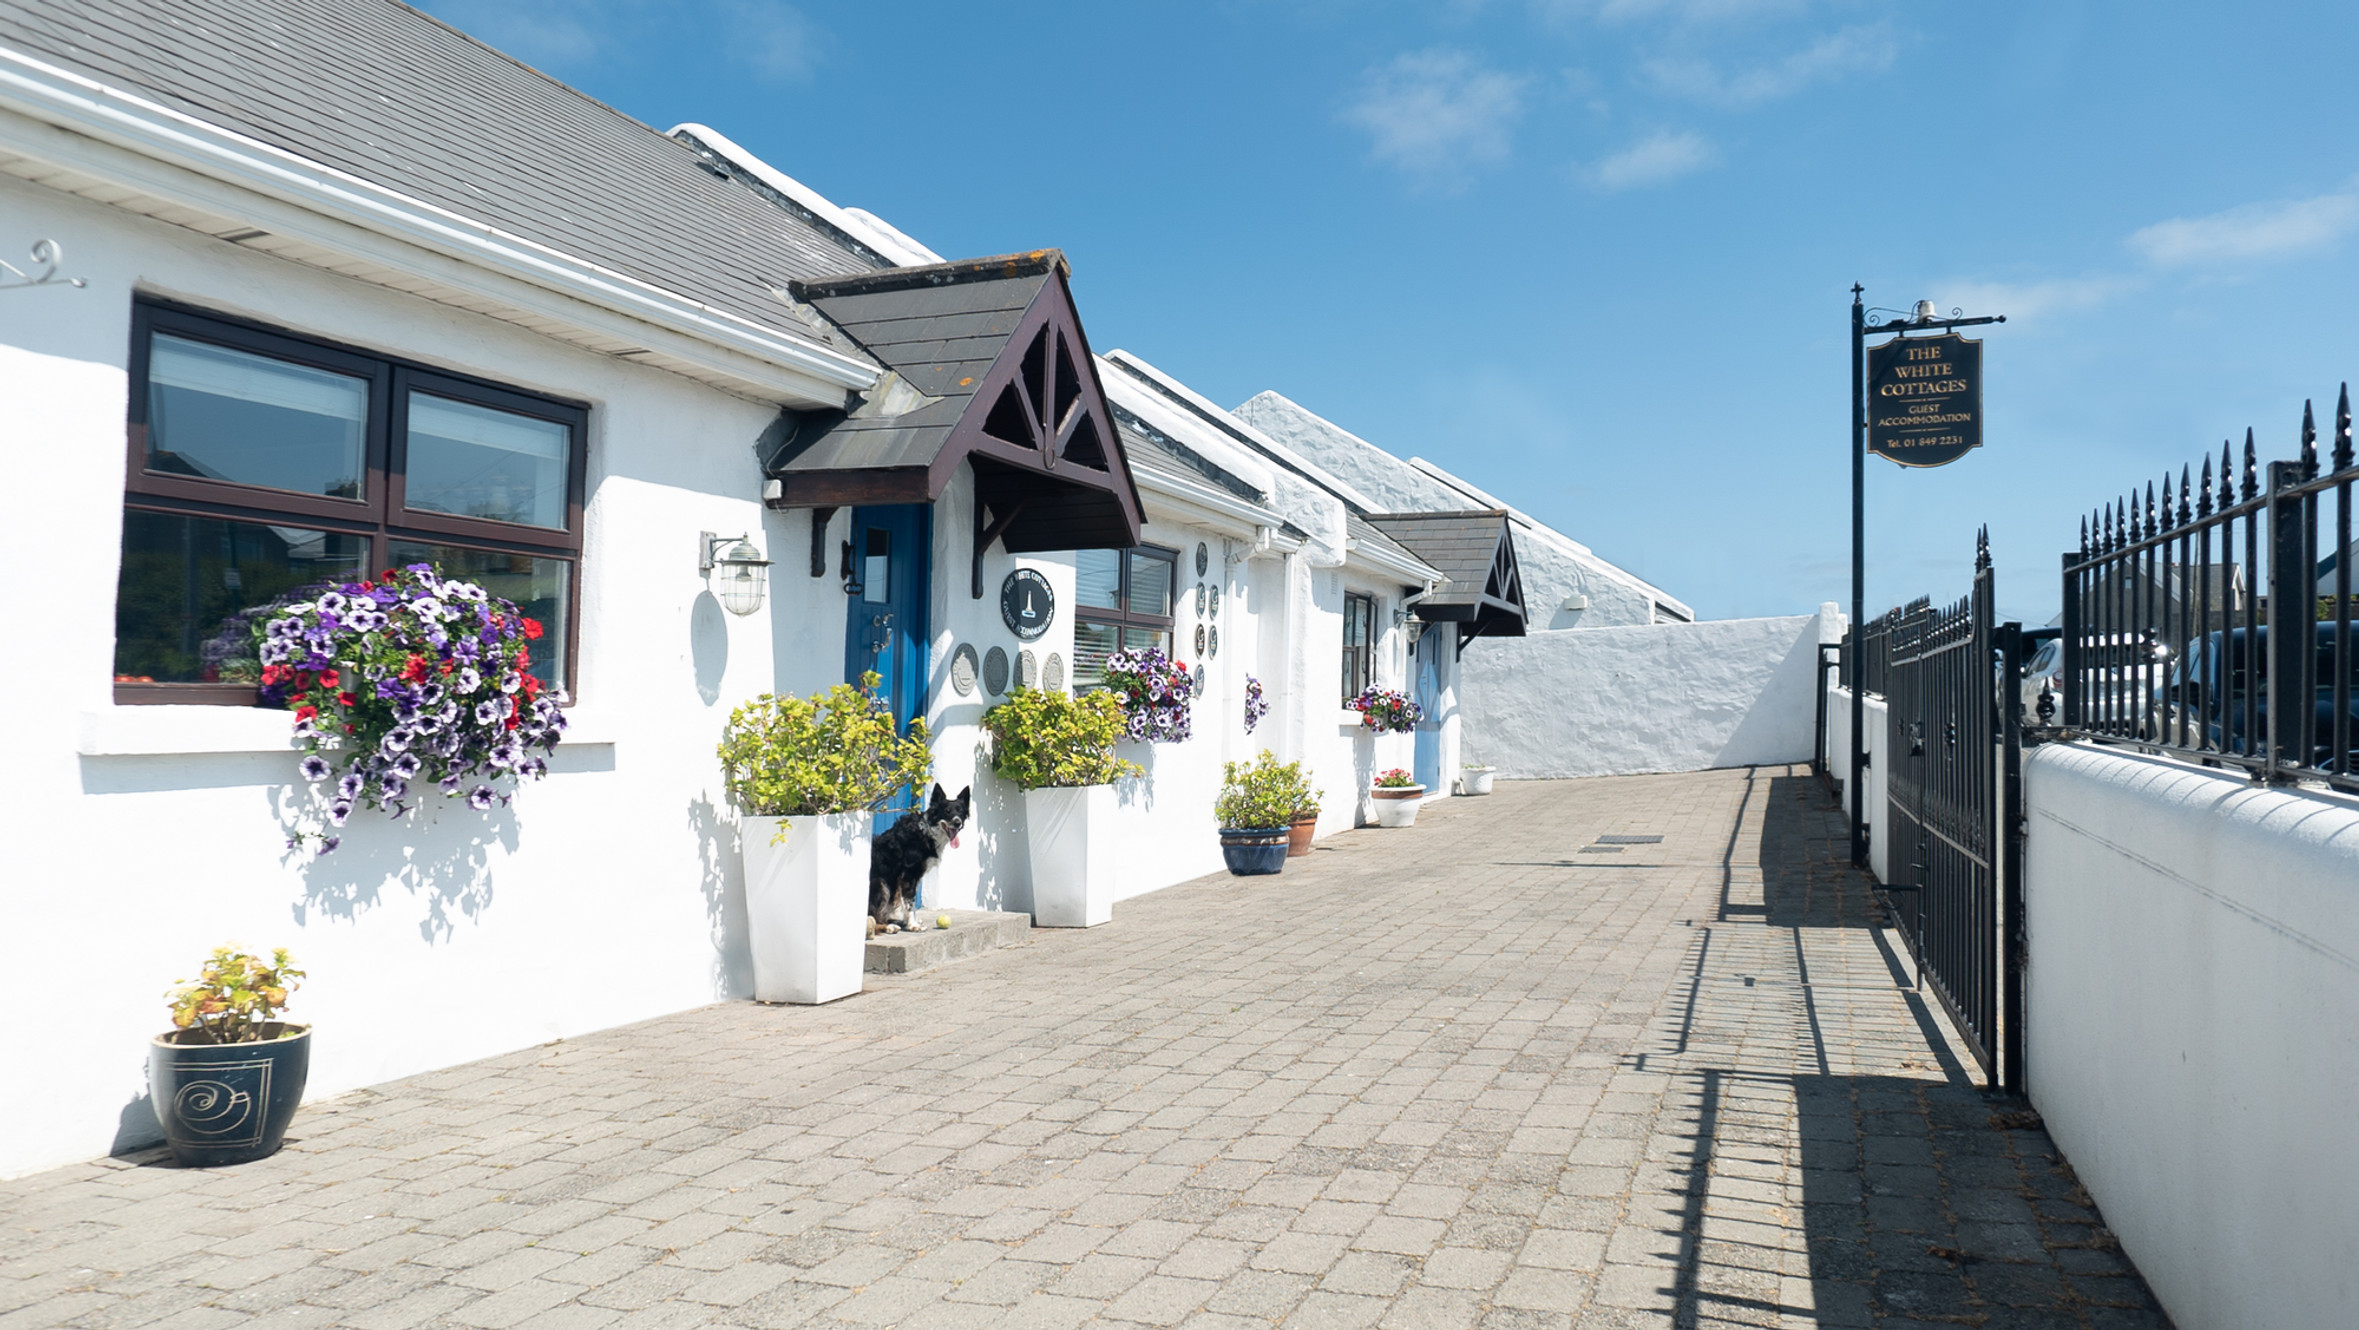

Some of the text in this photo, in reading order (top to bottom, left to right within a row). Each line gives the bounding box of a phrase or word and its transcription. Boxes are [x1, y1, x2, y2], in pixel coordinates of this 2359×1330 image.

[1906, 346, 1941, 361] THE
[1894, 363, 1953, 379] WHITE
[1880, 379, 1967, 397] COTTAGES
[1908, 403, 1940, 415] GUEST
[1878, 413, 1971, 427] ACCOMMODATION
[1903, 438, 1916, 448] 01
[1918, 436, 1937, 447] 849
[1939, 435, 1963, 445] 2231
